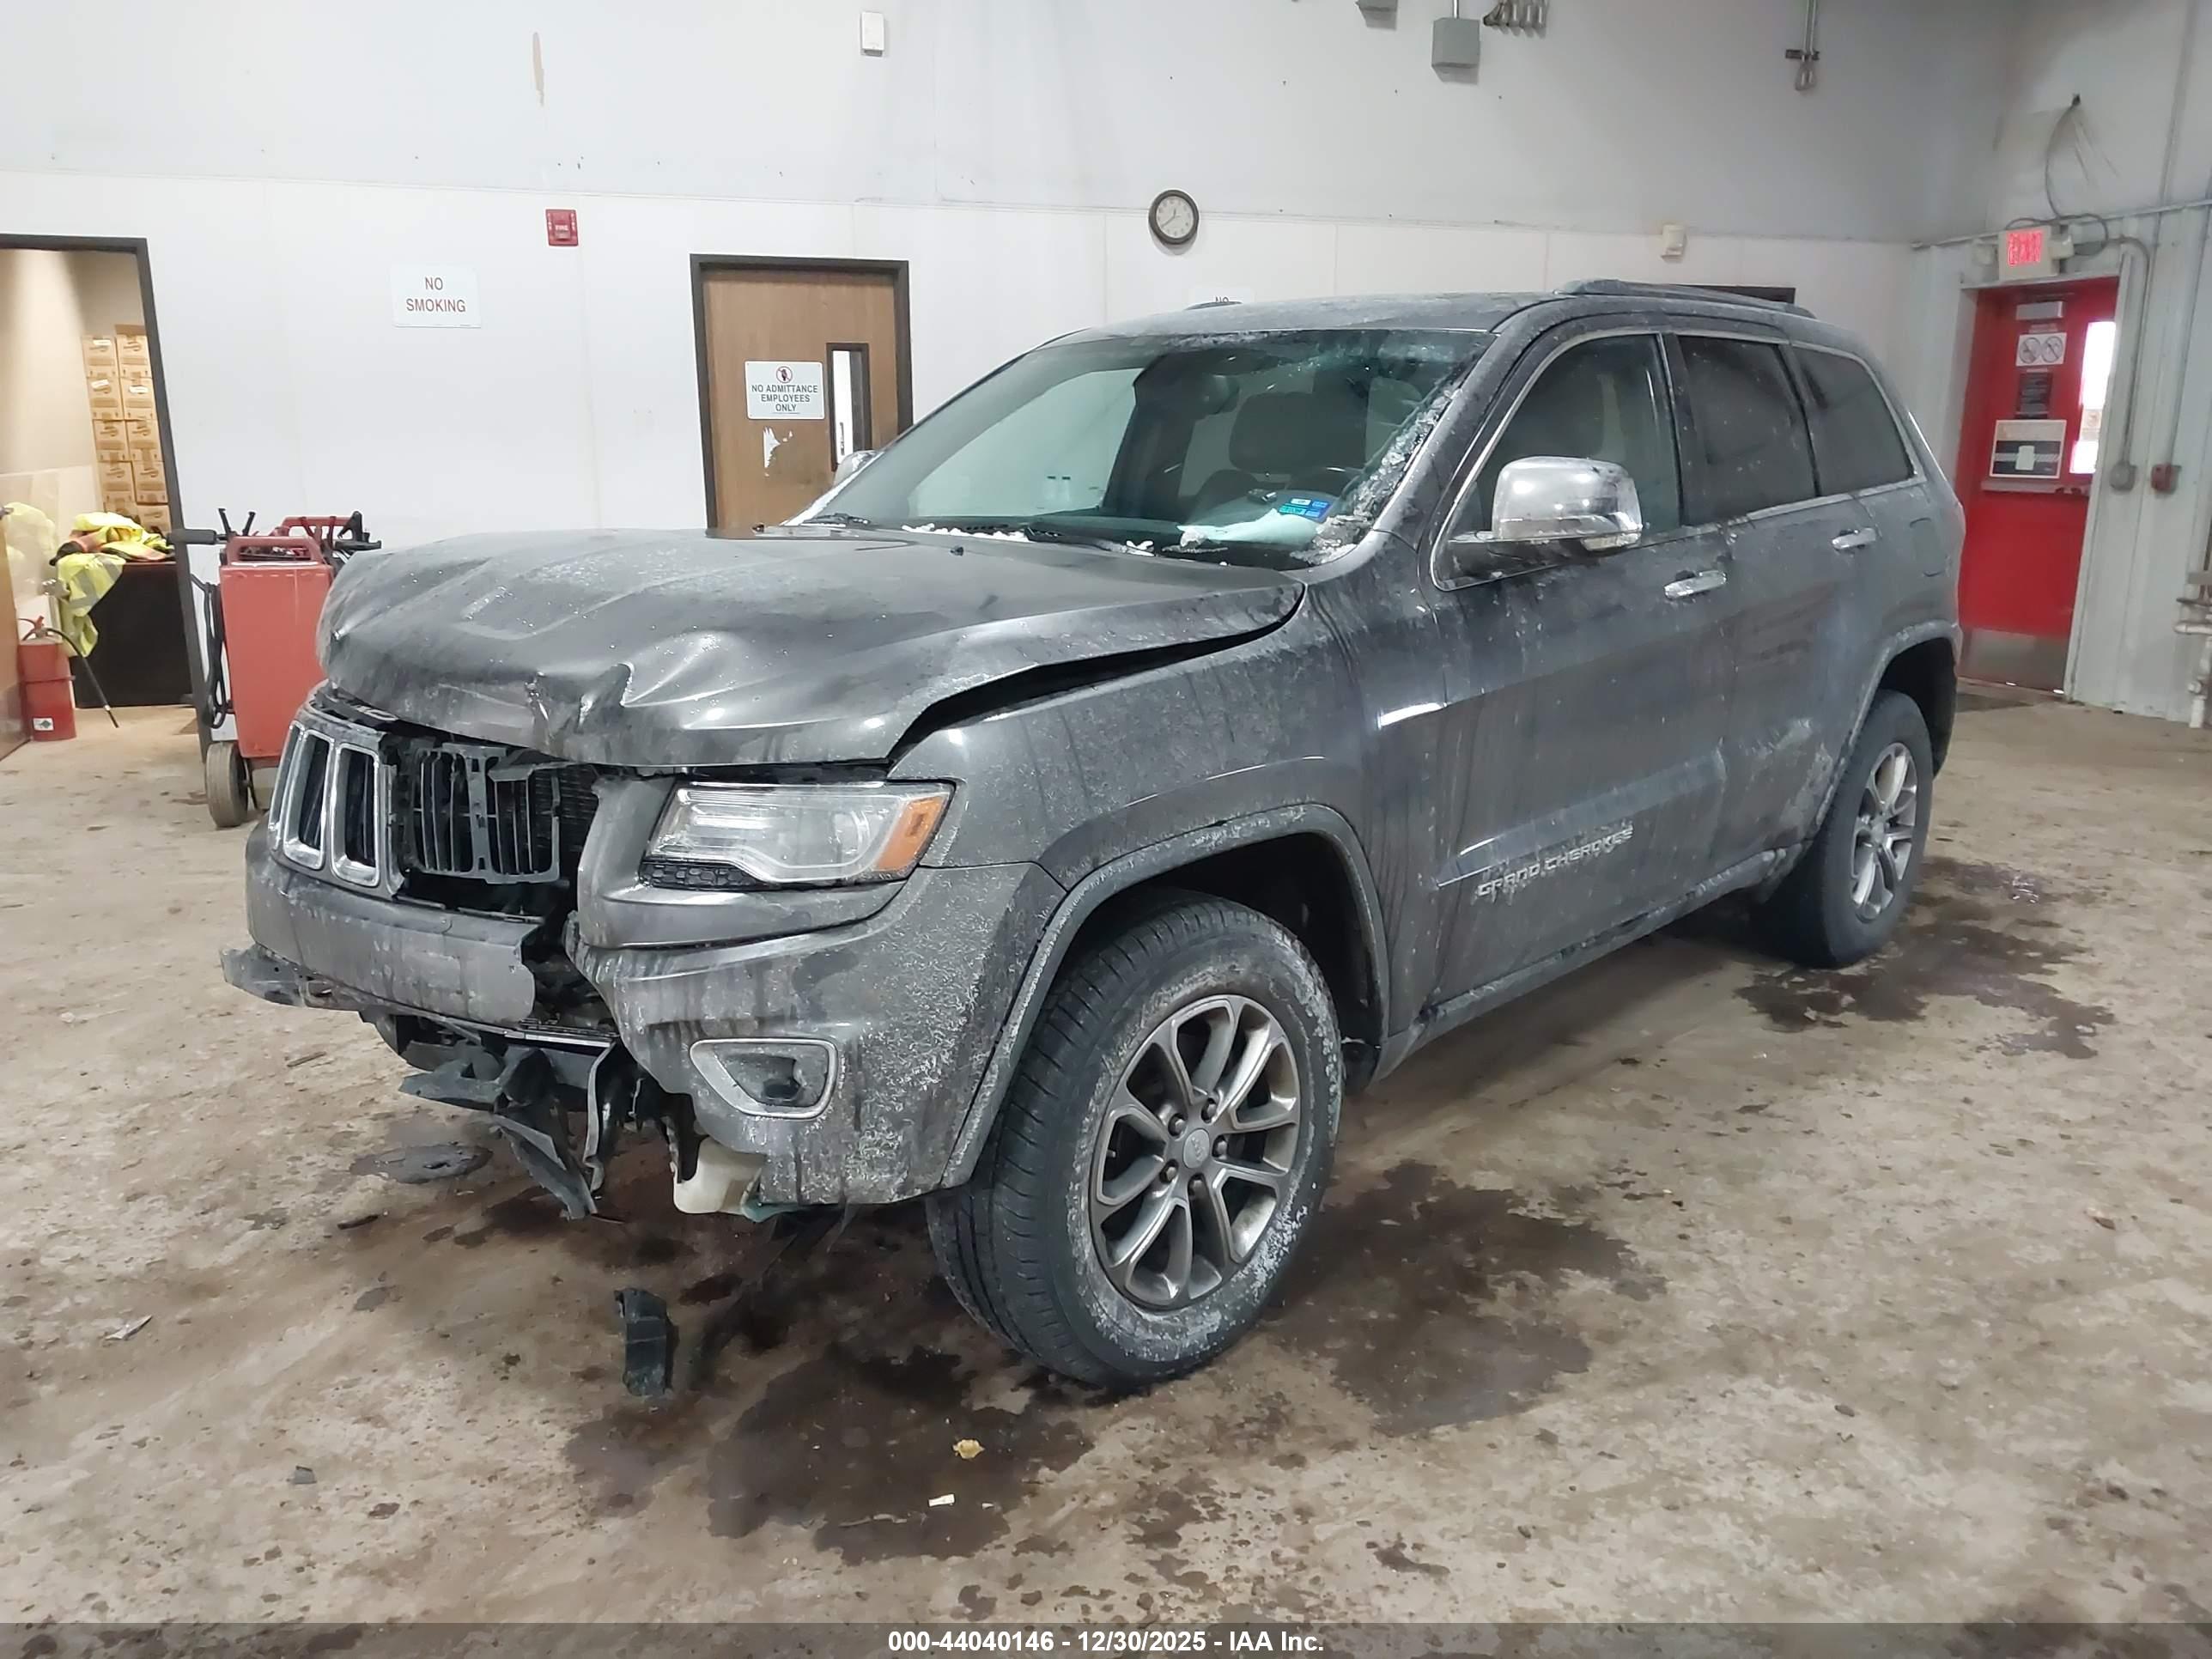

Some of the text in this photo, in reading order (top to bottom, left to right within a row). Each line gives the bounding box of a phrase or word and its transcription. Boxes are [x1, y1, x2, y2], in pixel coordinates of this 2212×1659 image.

[424, 276, 443, 290] NO
[406, 298, 466, 313] SMOKING
[751, 384, 818, 393] NO ADMITTANCE
[761, 394, 811, 403] EMPLOYEES
[775, 403, 797, 412] ONLY
